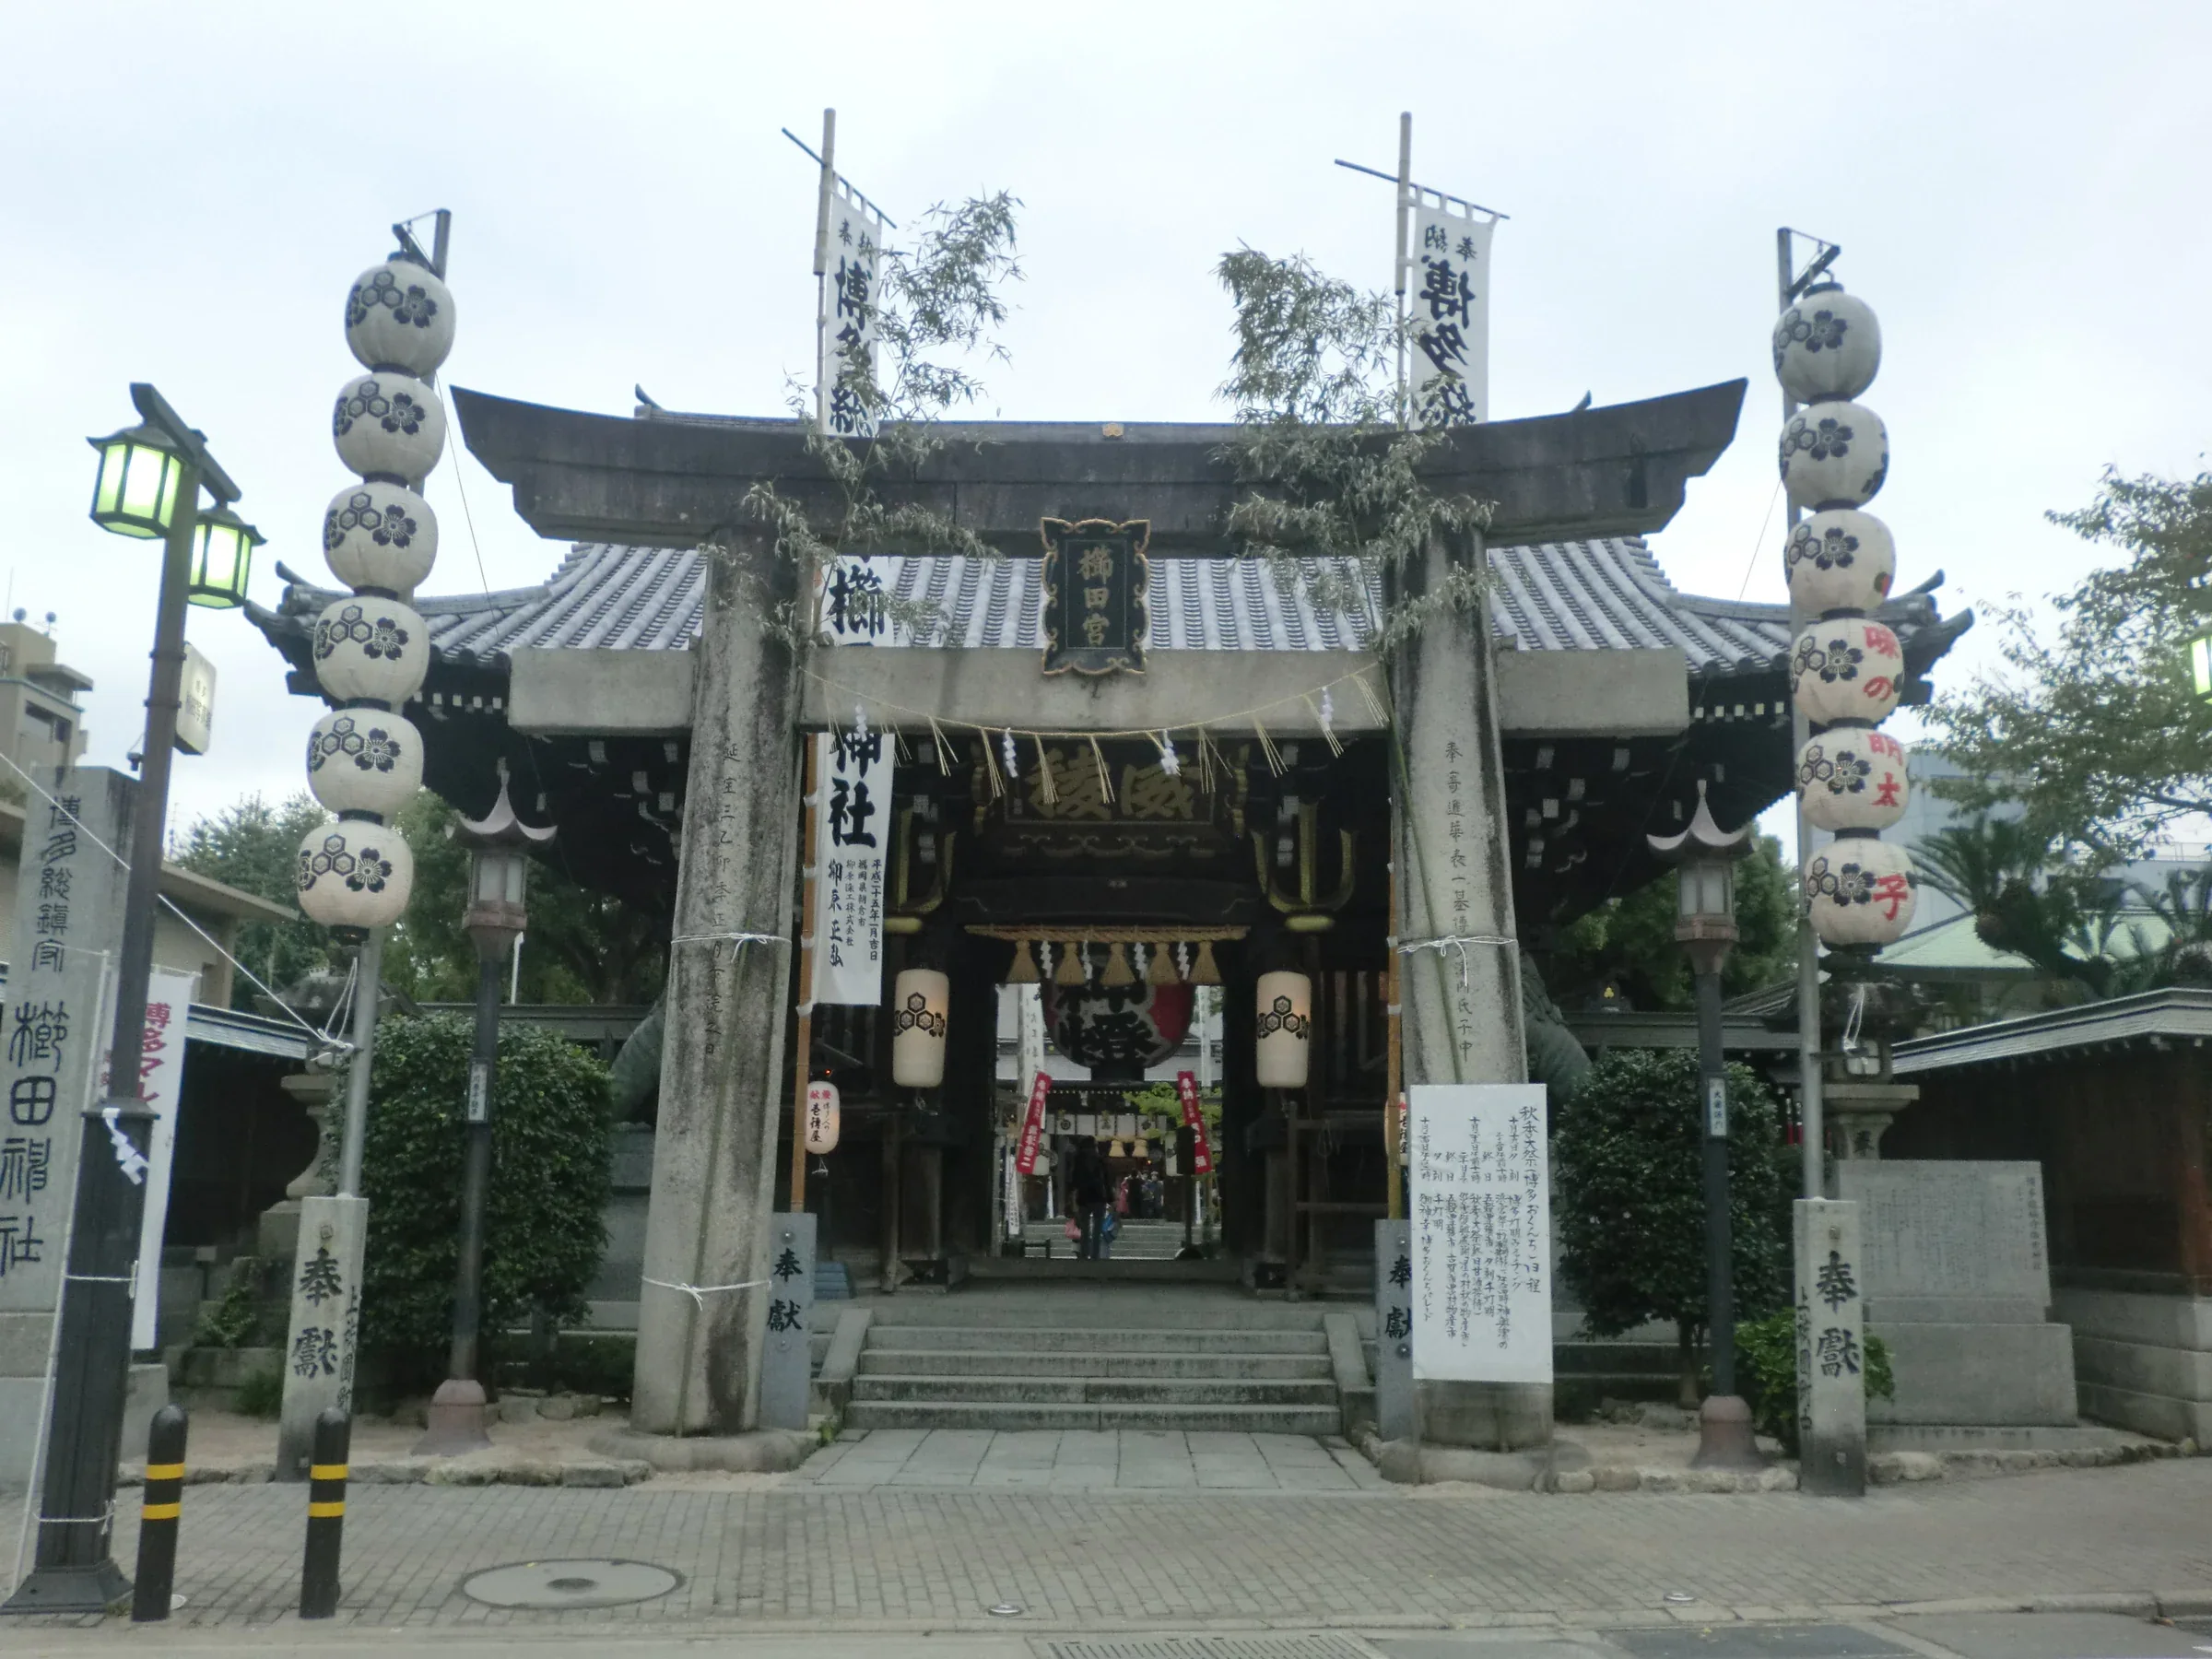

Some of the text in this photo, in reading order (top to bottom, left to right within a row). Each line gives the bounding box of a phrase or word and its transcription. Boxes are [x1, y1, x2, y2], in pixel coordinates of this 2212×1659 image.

[1077, 544, 1114, 647] 櫛田宮
[856, 858, 868, 927] 福岡県朝倉市
[868, 858, 883, 961] 平成二十五年一月吉日
